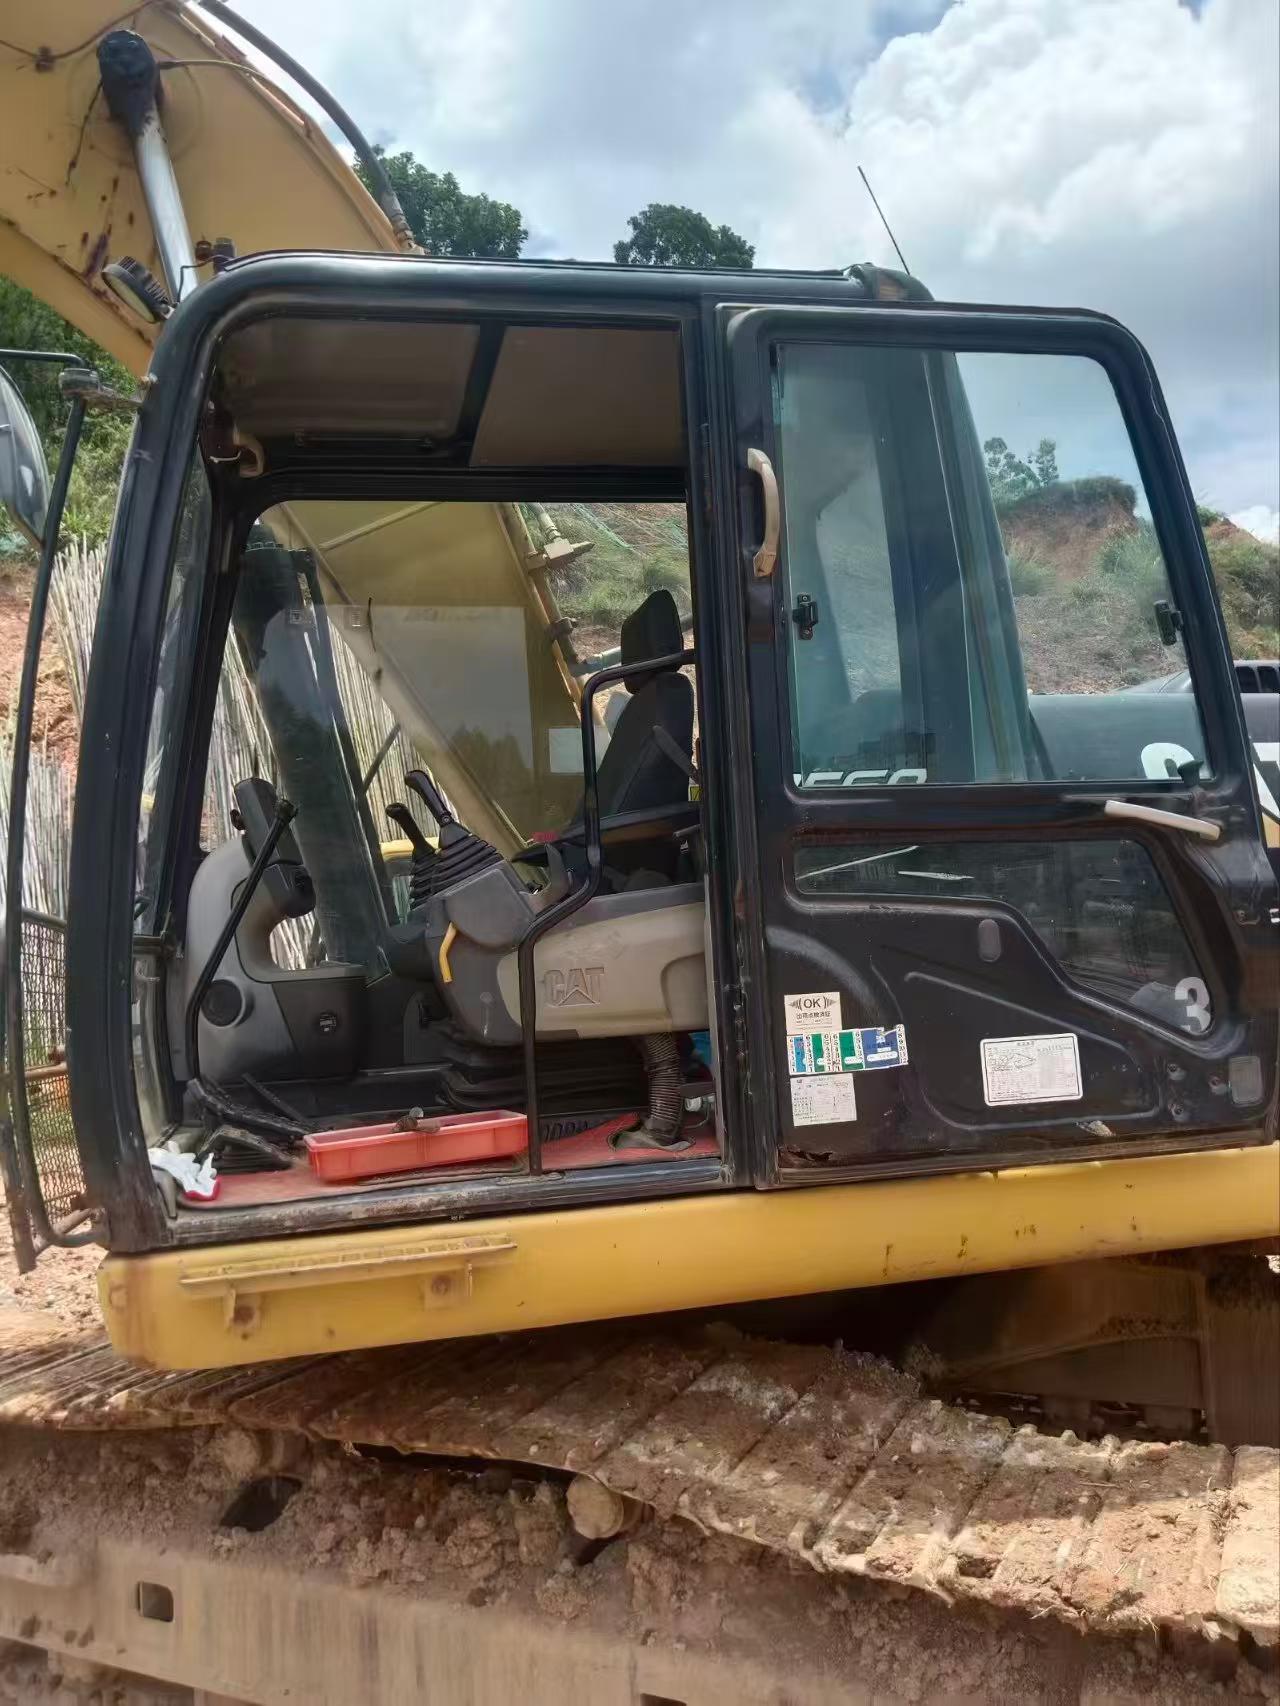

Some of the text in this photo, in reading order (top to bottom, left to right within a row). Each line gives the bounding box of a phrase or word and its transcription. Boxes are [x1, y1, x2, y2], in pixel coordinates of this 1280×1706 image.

[544, 966, 607, 1007] CAT
[803, 998, 821, 1009] OK
[1174, 976, 1211, 1034] 3
